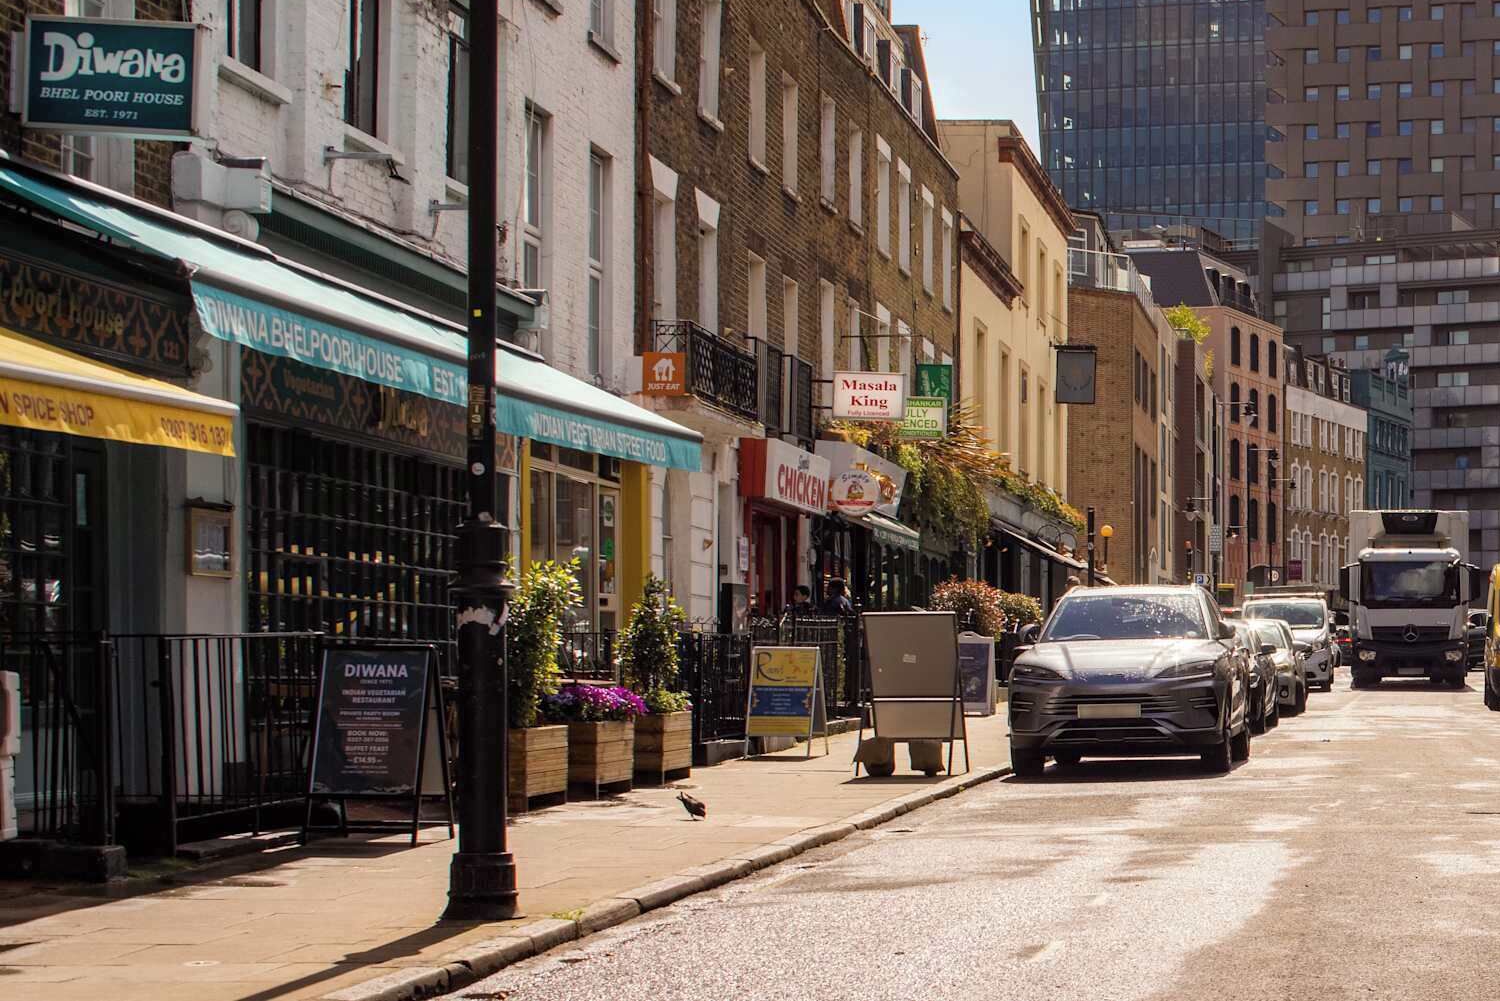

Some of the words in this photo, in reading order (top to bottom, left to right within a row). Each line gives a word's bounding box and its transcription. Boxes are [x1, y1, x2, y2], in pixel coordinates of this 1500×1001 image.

[40, 87, 80, 100] BHEL
[84, 89, 129, 102] POORI
[133, 91, 184, 105] HOUSE
[84, 108, 109, 118] EST.
[113, 110, 138, 119] 1971
[207, 297, 269, 345] DIWANA
[357, 344, 404, 382] HOUSE
[647, 383, 666, 391] JUST
[666, 383, 680, 391] EAT
[842, 380, 897, 391] Masala
[851, 395, 888, 409] King
[13, 392, 57, 421] SPICE
[59, 400, 94, 427] SHOP
[906, 408, 928, 418] ULLY
[903, 419, 938, 429] ENCED
[565, 420, 616, 451] VEGETARIAN
[616, 432, 645, 457] STREET
[646, 438, 667, 462] FOOD
[777, 463, 826, 511] CHICKEN
[344, 664, 408, 678] DIWANA
